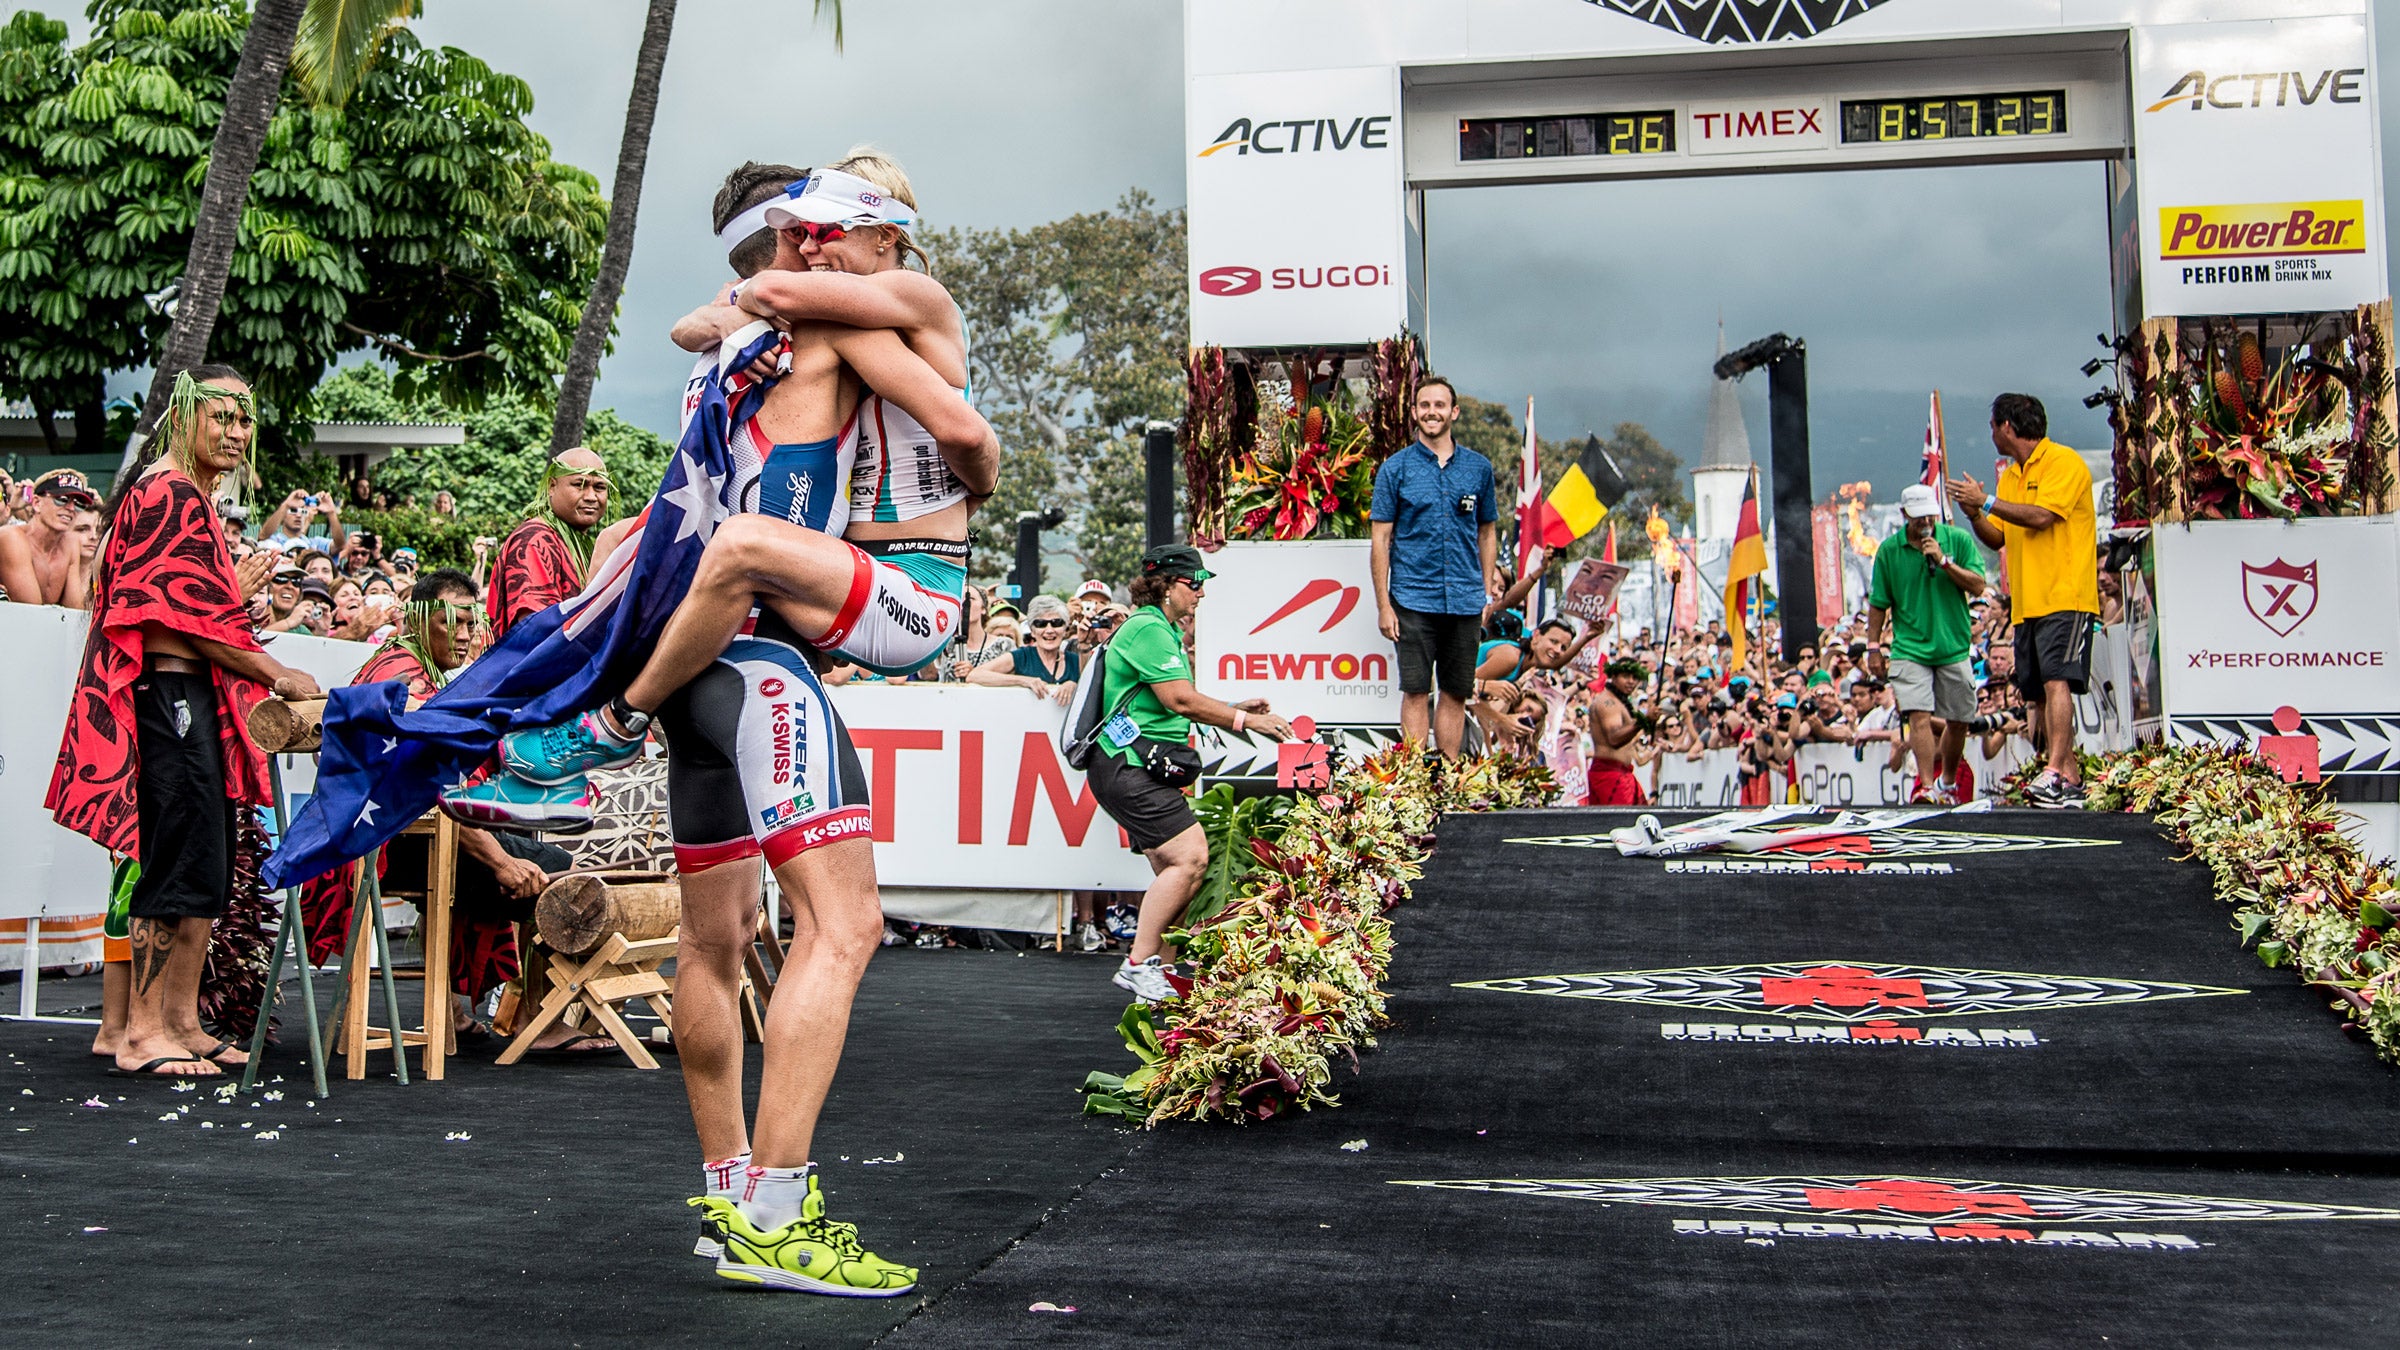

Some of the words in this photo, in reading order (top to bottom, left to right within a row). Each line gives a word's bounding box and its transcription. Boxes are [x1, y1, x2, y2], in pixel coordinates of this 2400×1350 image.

[2145, 68, 2365, 112] ACTIVE
[1197, 116, 1392, 157] ACTIVE
[1693, 108, 1822, 139] TIMEX
[2169, 210, 2355, 250] PowerBar
[2182, 265, 2270, 284] PERFORM
[2275, 259, 2317, 269] SPORTS
[2275, 271, 2308, 282] DRINK
[2312, 270, 2332, 281] MIX
[1326, 682, 1388, 698] running
[793, 697, 807, 790] TREK
[848, 728, 1131, 848] TIM
[1801, 764, 1853, 807] oPro
[1660, 1020, 2037, 1041] IRONMAN
[1671, 1219, 2198, 1244] IRONMAN
